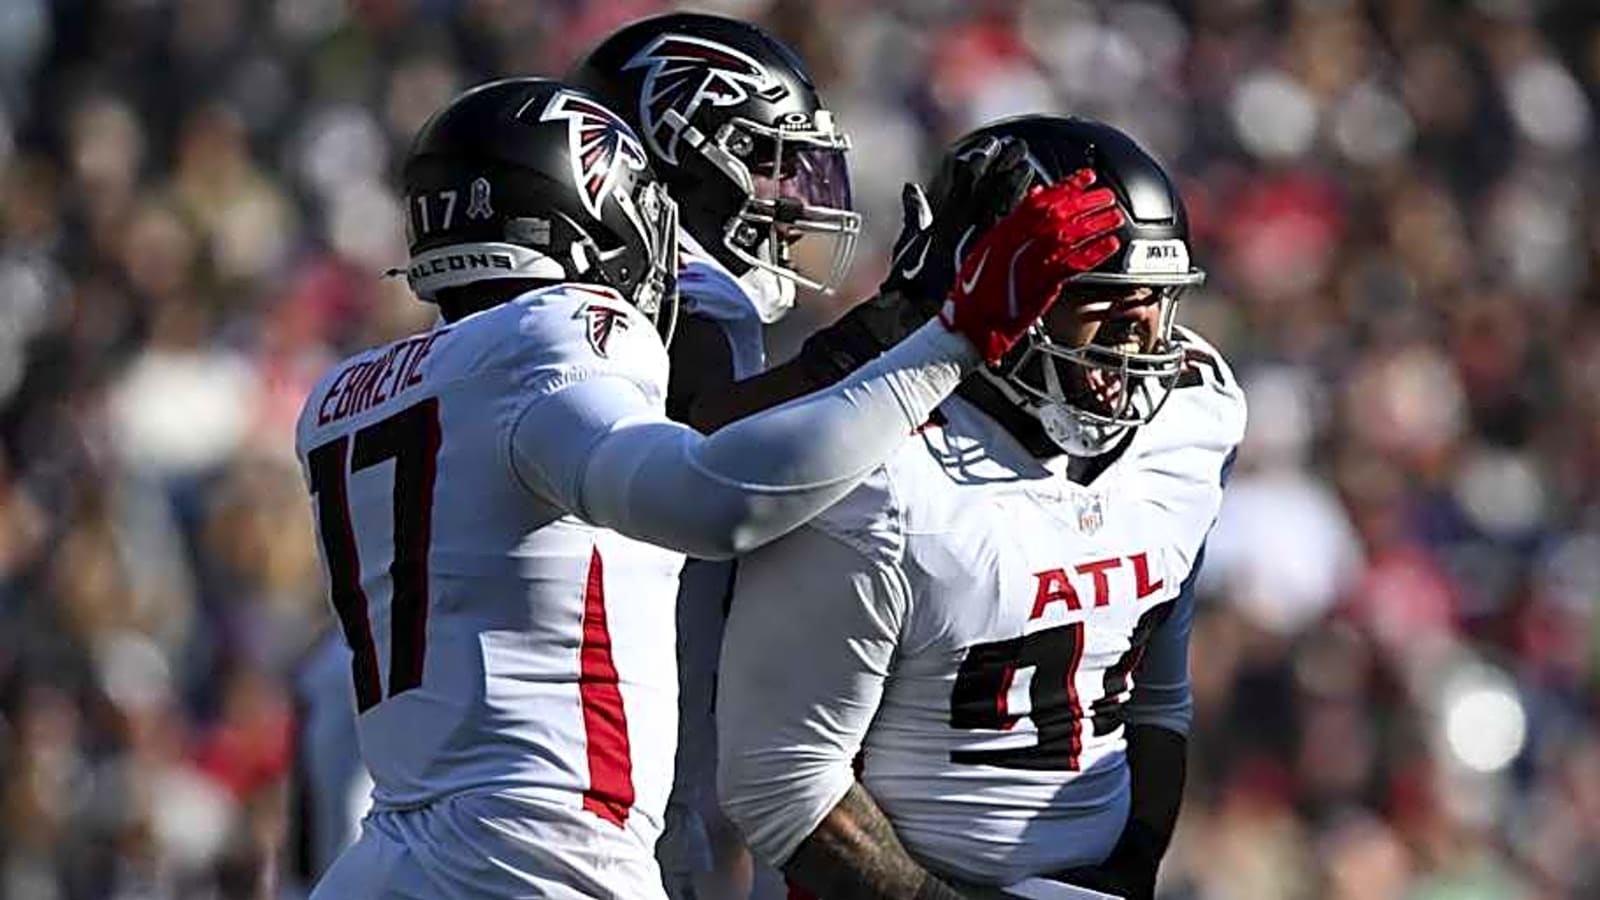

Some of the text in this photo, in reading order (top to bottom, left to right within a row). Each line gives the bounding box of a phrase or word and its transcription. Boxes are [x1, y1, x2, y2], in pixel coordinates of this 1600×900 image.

[418, 190, 457, 232] 17
[410, 253, 512, 278] ALCONS
[307, 396, 442, 715] 17
[1029, 552, 1164, 621] ATL
